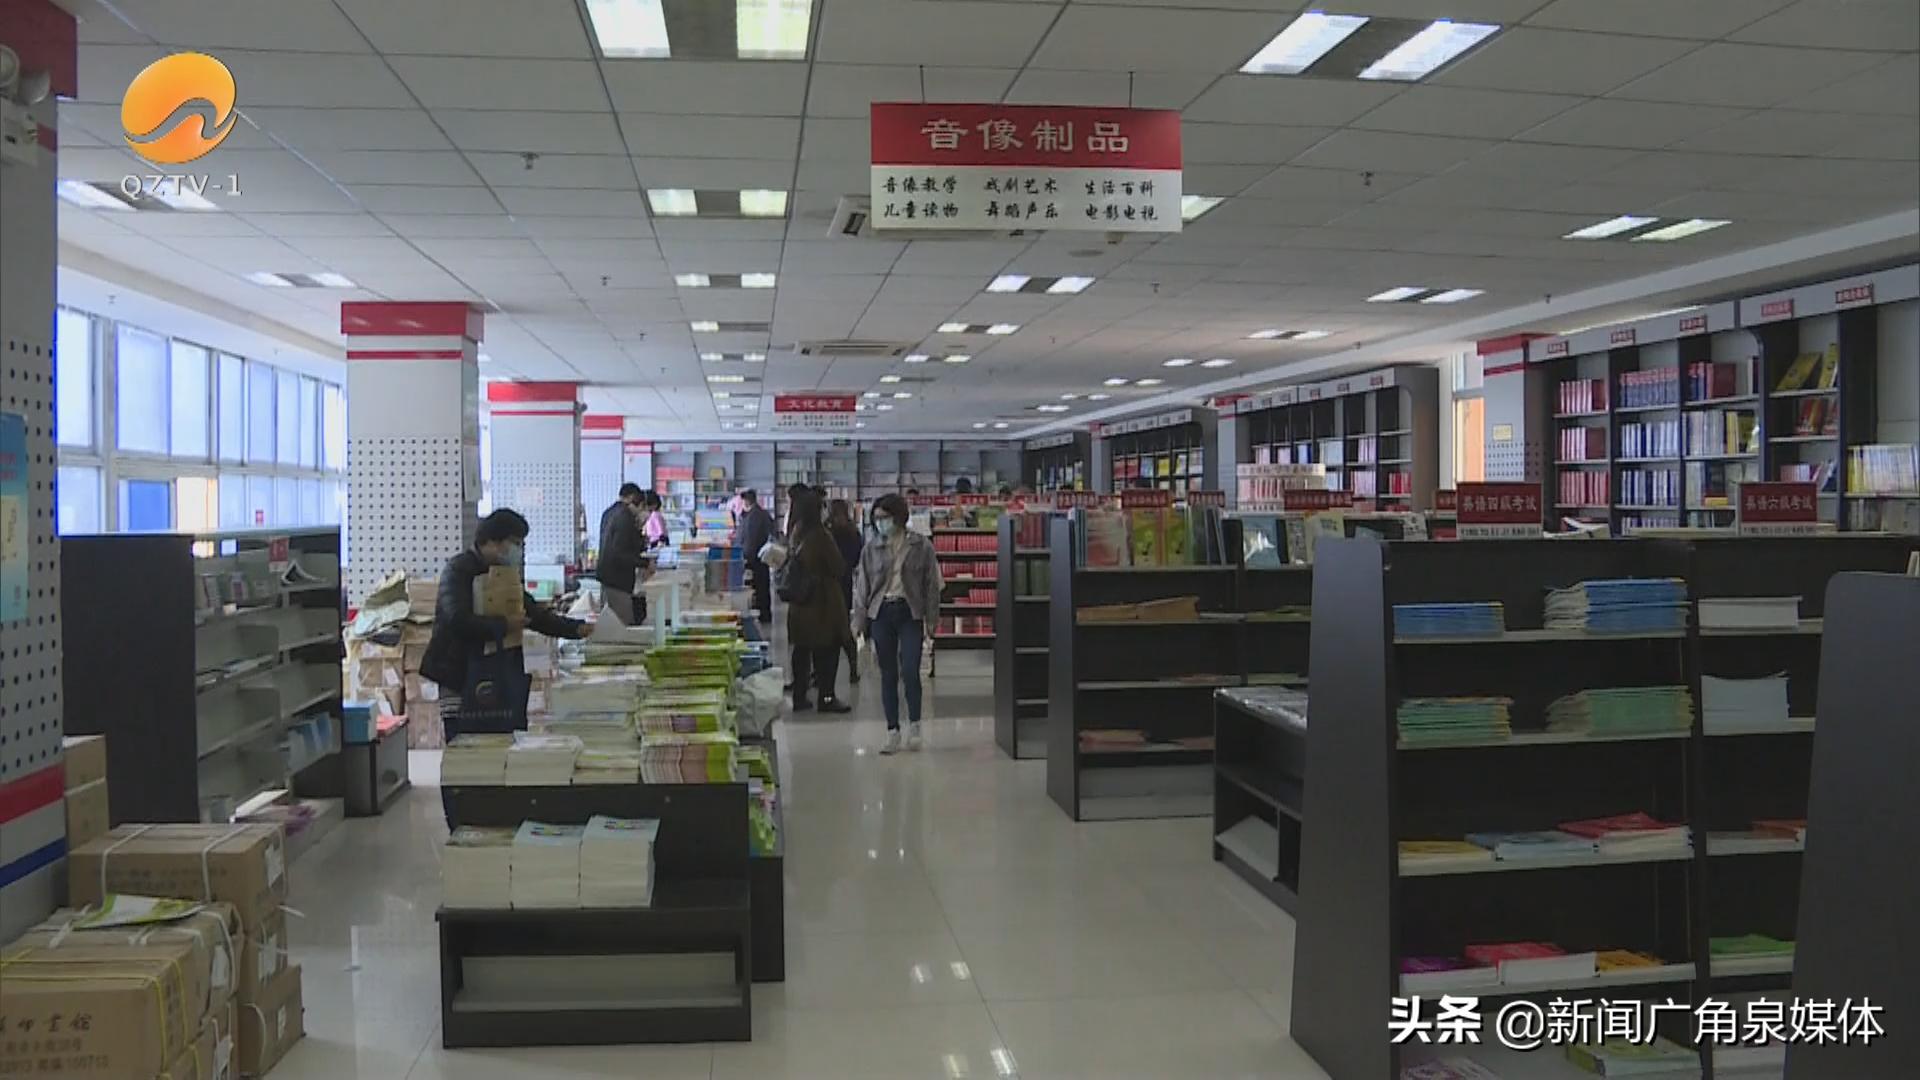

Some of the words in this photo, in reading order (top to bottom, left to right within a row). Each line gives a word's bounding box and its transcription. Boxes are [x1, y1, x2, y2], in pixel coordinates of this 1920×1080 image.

[921, 119, 1129, 153] 音像制品
[882, 176, 958, 194] 音像教学
[1084, 180, 1154, 197] 生活百科
[884, 200, 959, 219] 儿童读物
[1085, 204, 1158, 221] 电影电视
[1462, 495, 1537, 512] 英语四级考试
